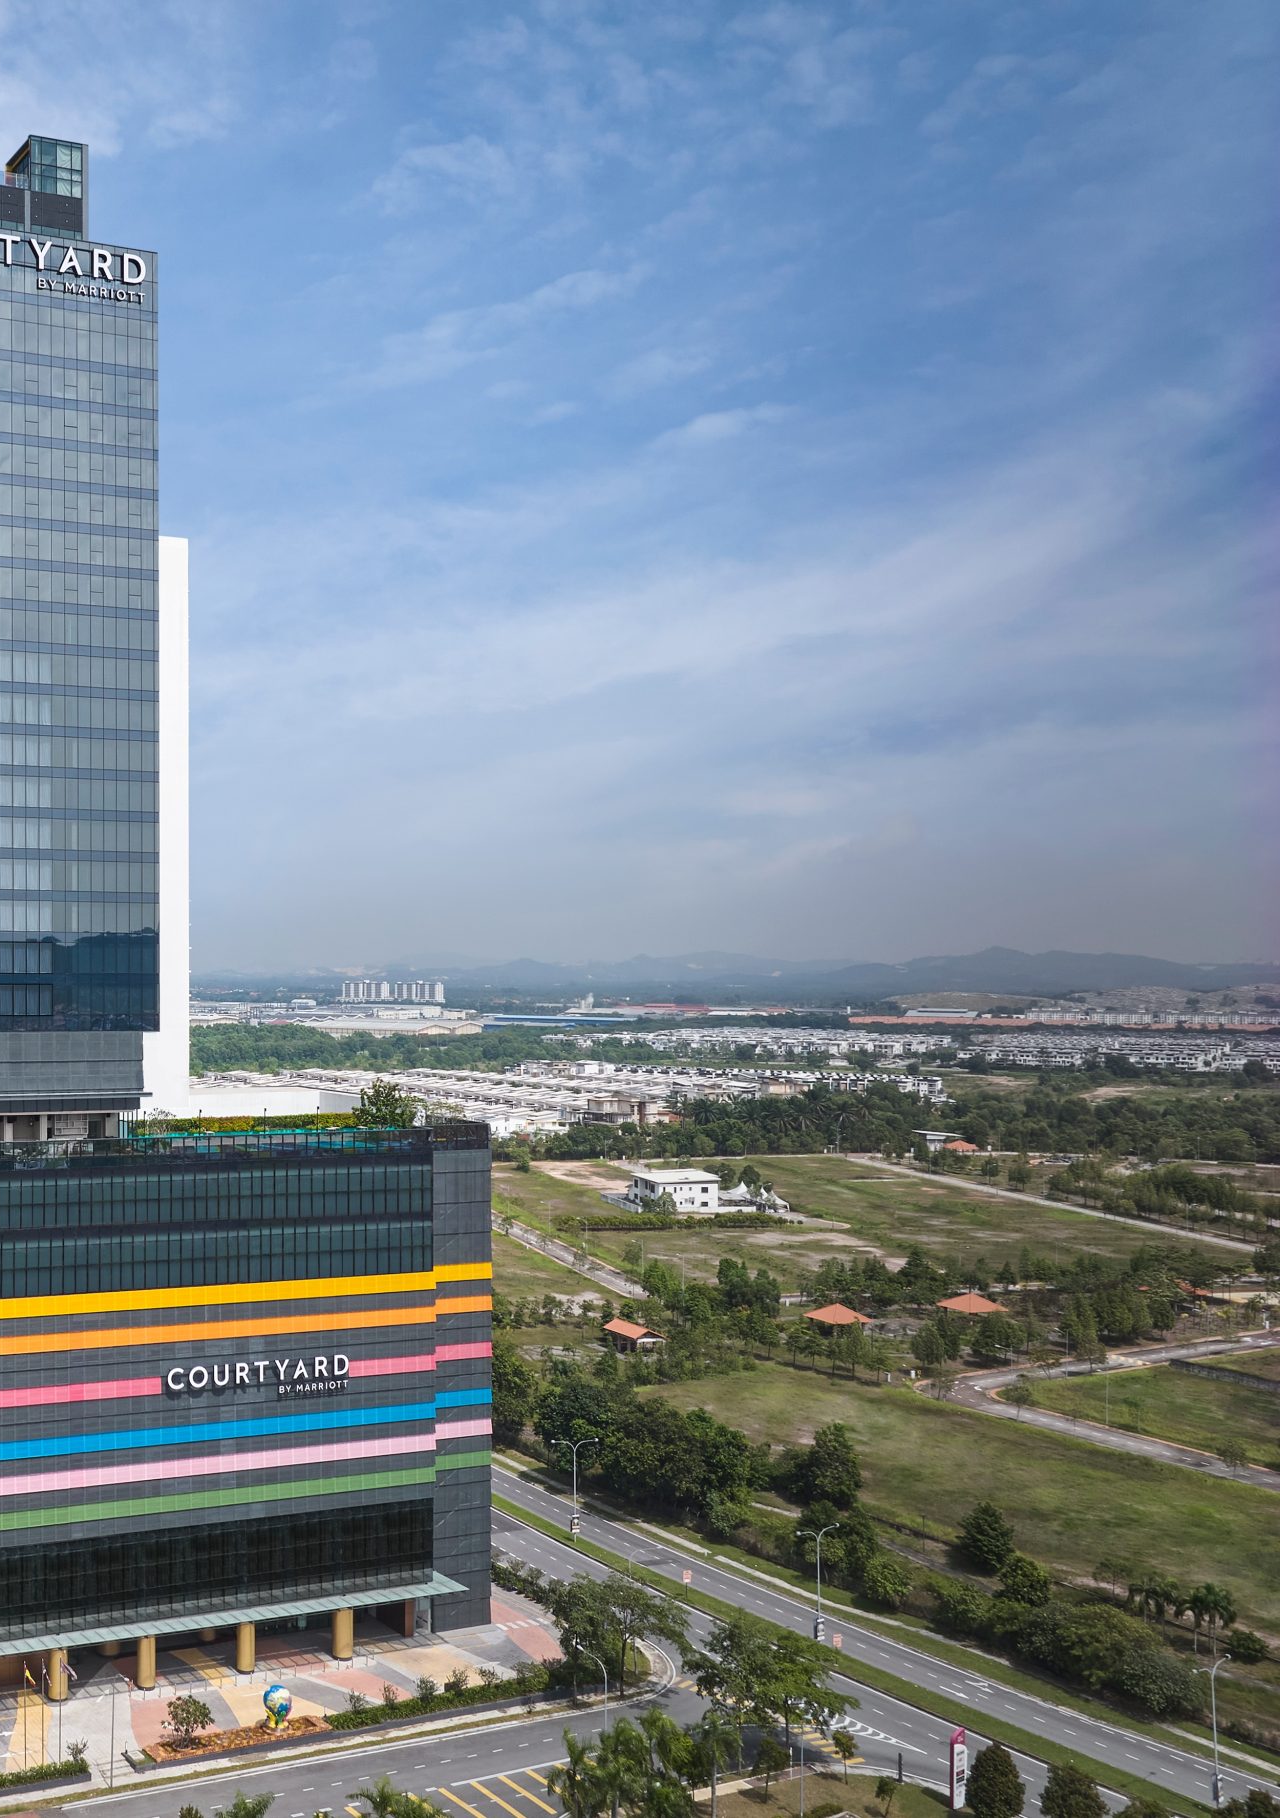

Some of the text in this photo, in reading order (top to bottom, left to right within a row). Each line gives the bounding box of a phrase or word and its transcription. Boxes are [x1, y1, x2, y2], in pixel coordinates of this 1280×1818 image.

[38, 277, 146, 303] BY MARRIOTT
[167, 1354, 349, 1390] COURTYARD
[279, 1380, 349, 1394] BY MARRIOTT
